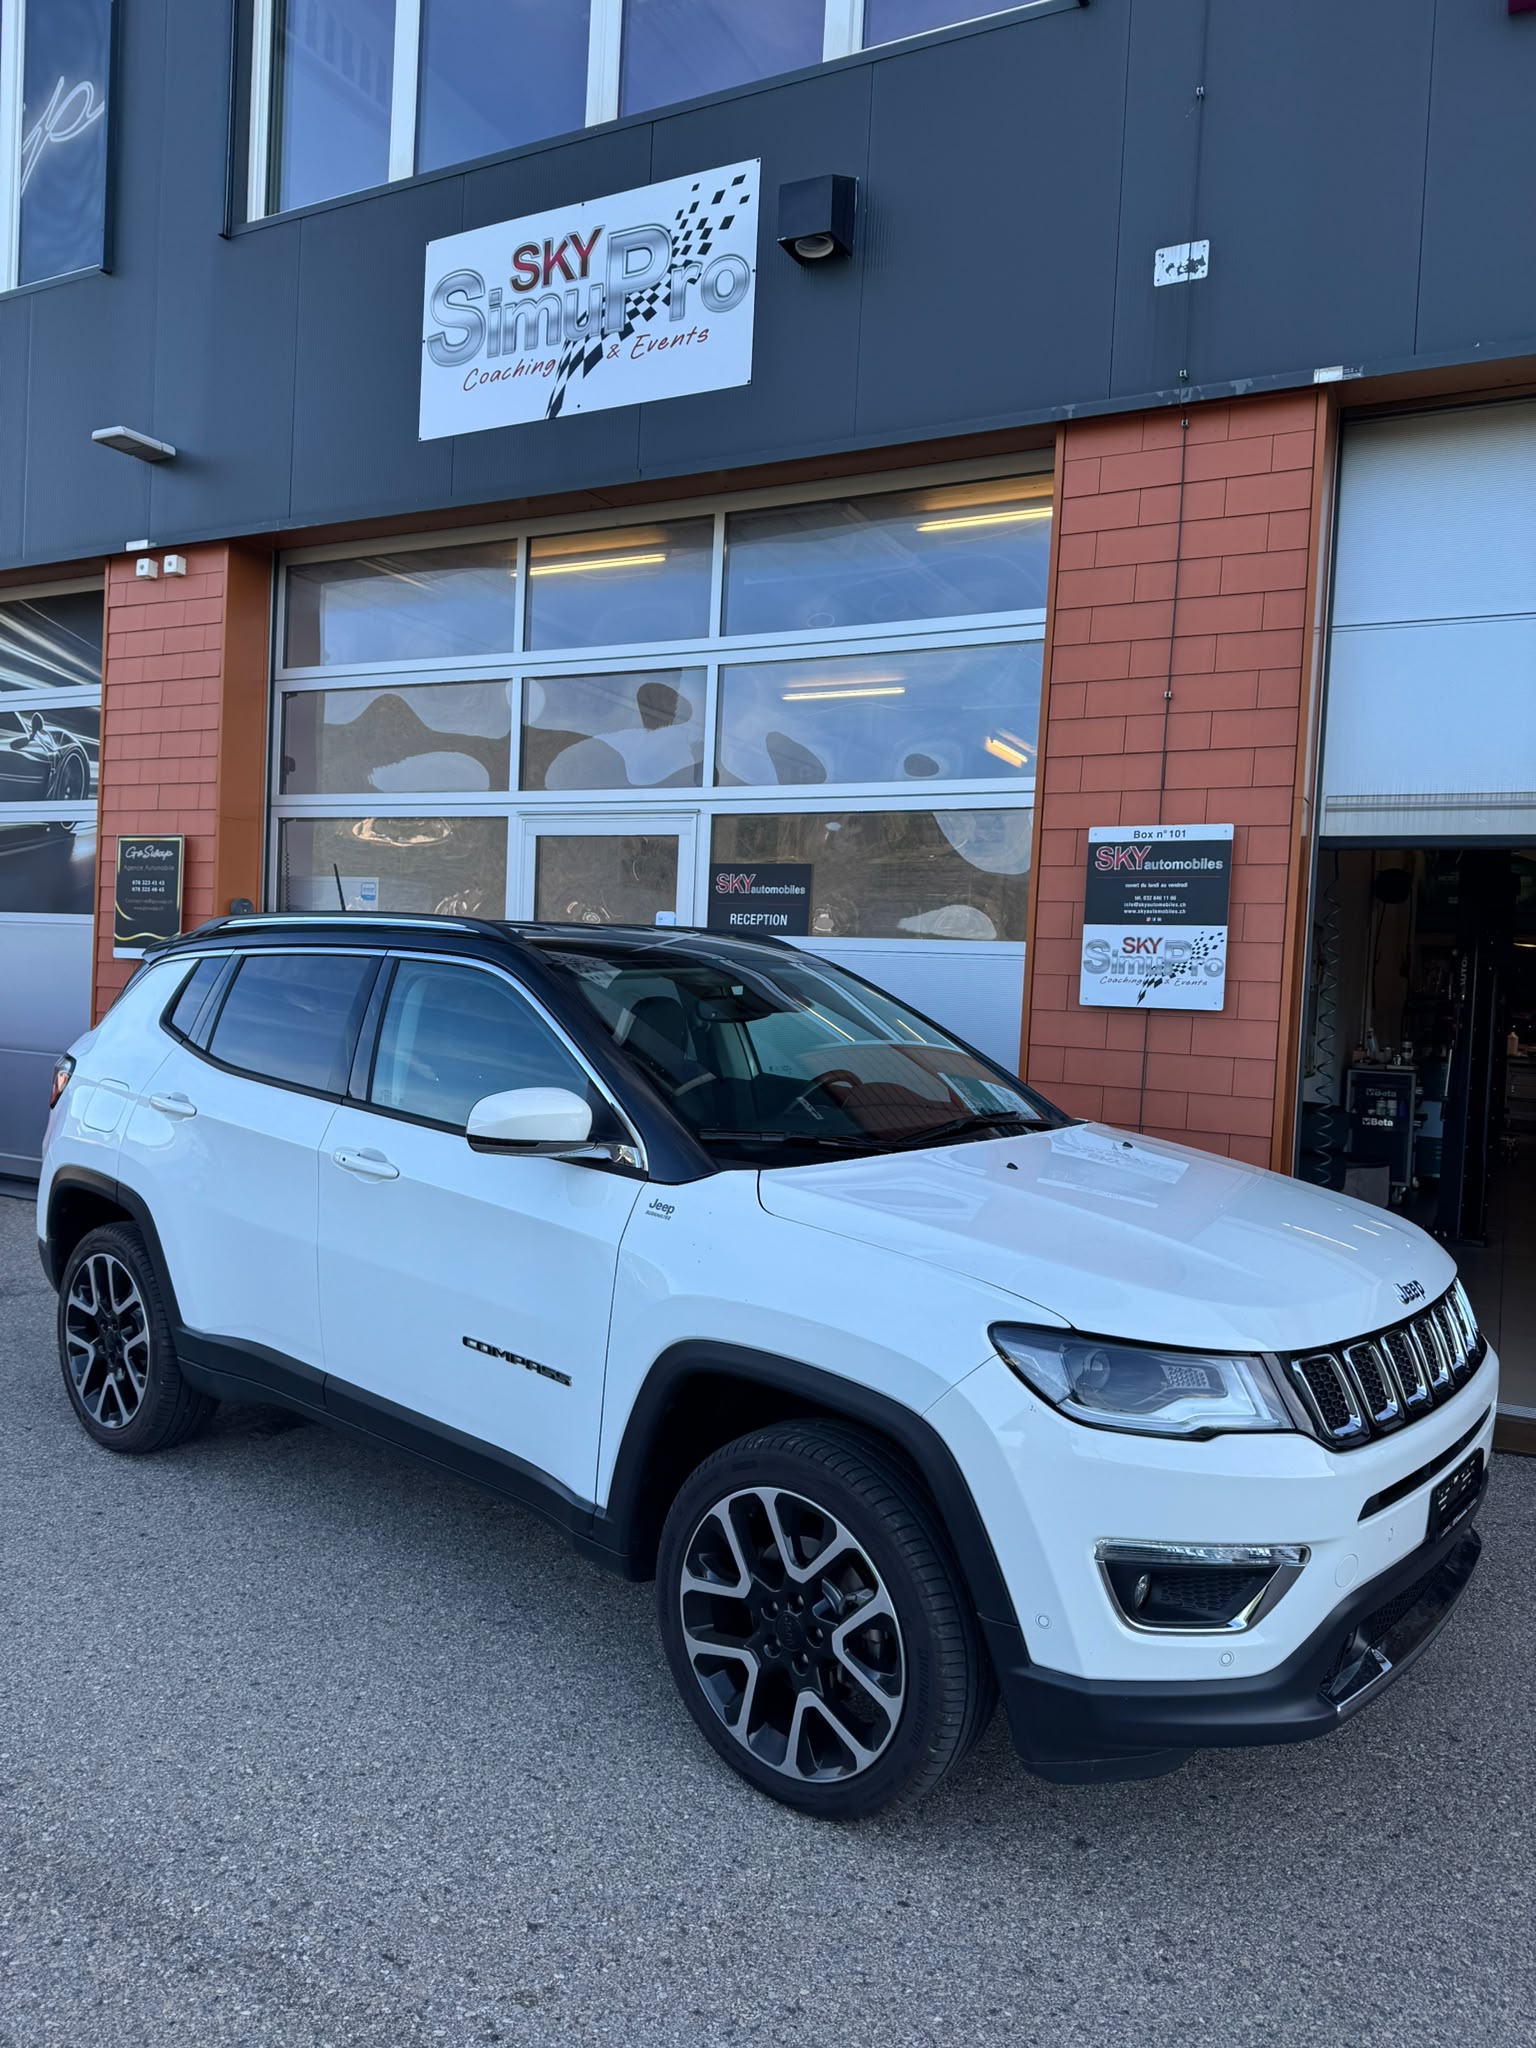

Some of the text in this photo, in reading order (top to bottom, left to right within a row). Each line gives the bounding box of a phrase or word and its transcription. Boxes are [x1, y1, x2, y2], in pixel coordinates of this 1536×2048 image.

[510, 225, 605, 294] SKY
[427, 223, 750, 368] SimuPro
[462, 326, 709, 392] Coaching & Events
[1133, 830, 1153, 839] Box
[730, 913, 788, 926] RECEPTION
[1122, 936, 1164, 954] SKY
[1083, 938, 1225, 978] SimuPro
[1099, 976, 1144, 986] Coaching
[1174, 978, 1208, 987] Events
[1370, 1117, 1394, 1127] Beta
[649, 1198, 676, 1215] Jeep
[1393, 1280, 1426, 1305] Jeep
[462, 1336, 572, 1387] COMPASS
